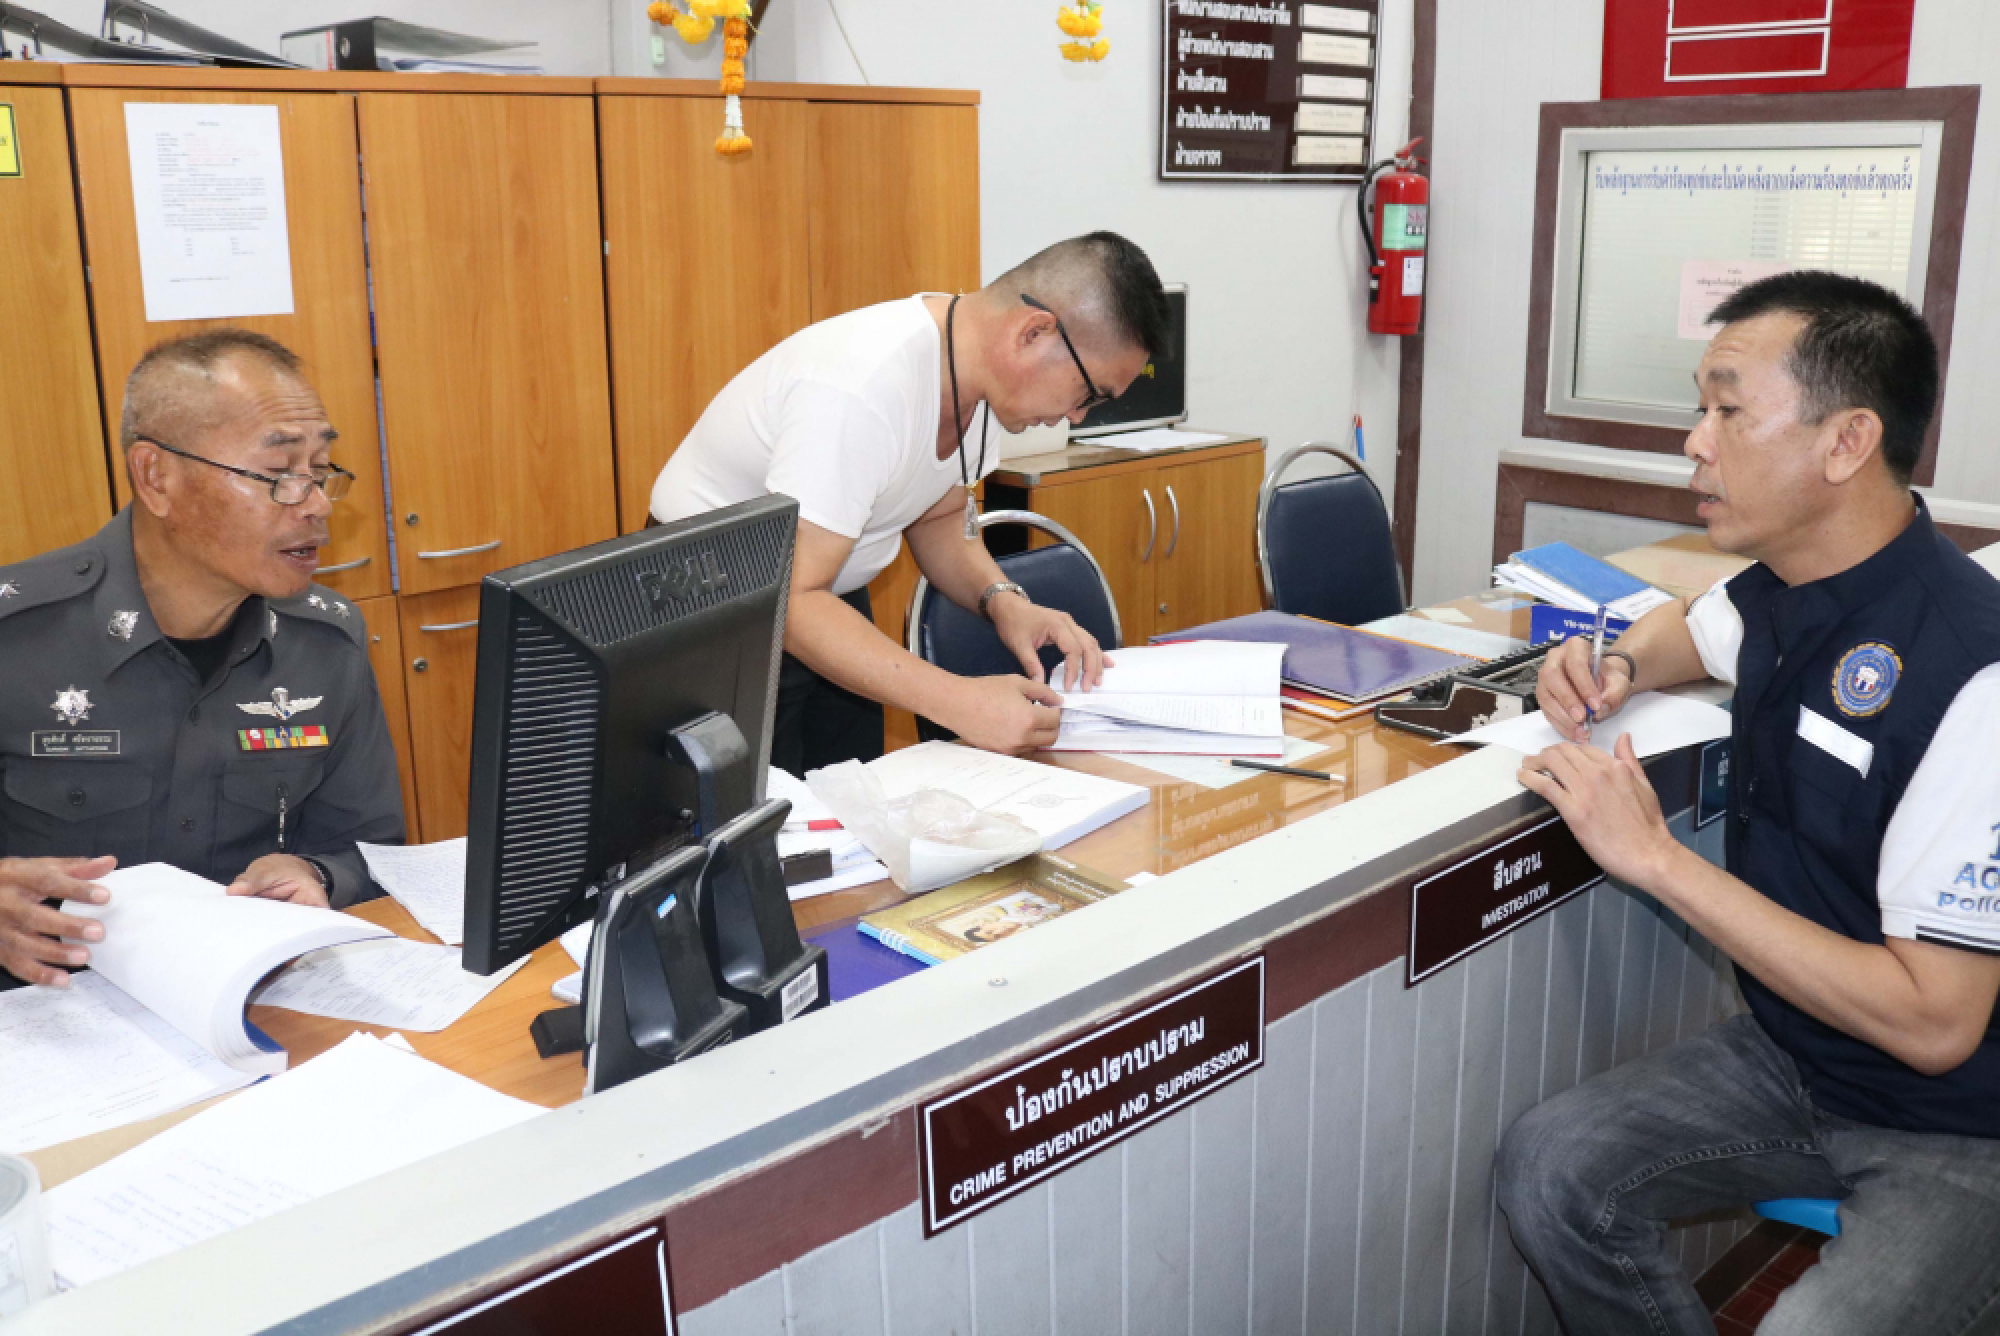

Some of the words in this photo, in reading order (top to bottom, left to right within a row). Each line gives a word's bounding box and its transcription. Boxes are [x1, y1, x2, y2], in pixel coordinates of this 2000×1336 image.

[1481, 881, 1551, 930] INVESTIGATION
[1493, 850, 1543, 891] สืบสวน
[1005, 1016, 1205, 1131] ป้องกันปราบปราม
[949, 1161, 1007, 1206] CRIME
[1013, 1110, 1113, 1176] PREVENTION
[1118, 1091, 1149, 1123] AND
[1155, 1041, 1249, 1103] SUPPRESSION
